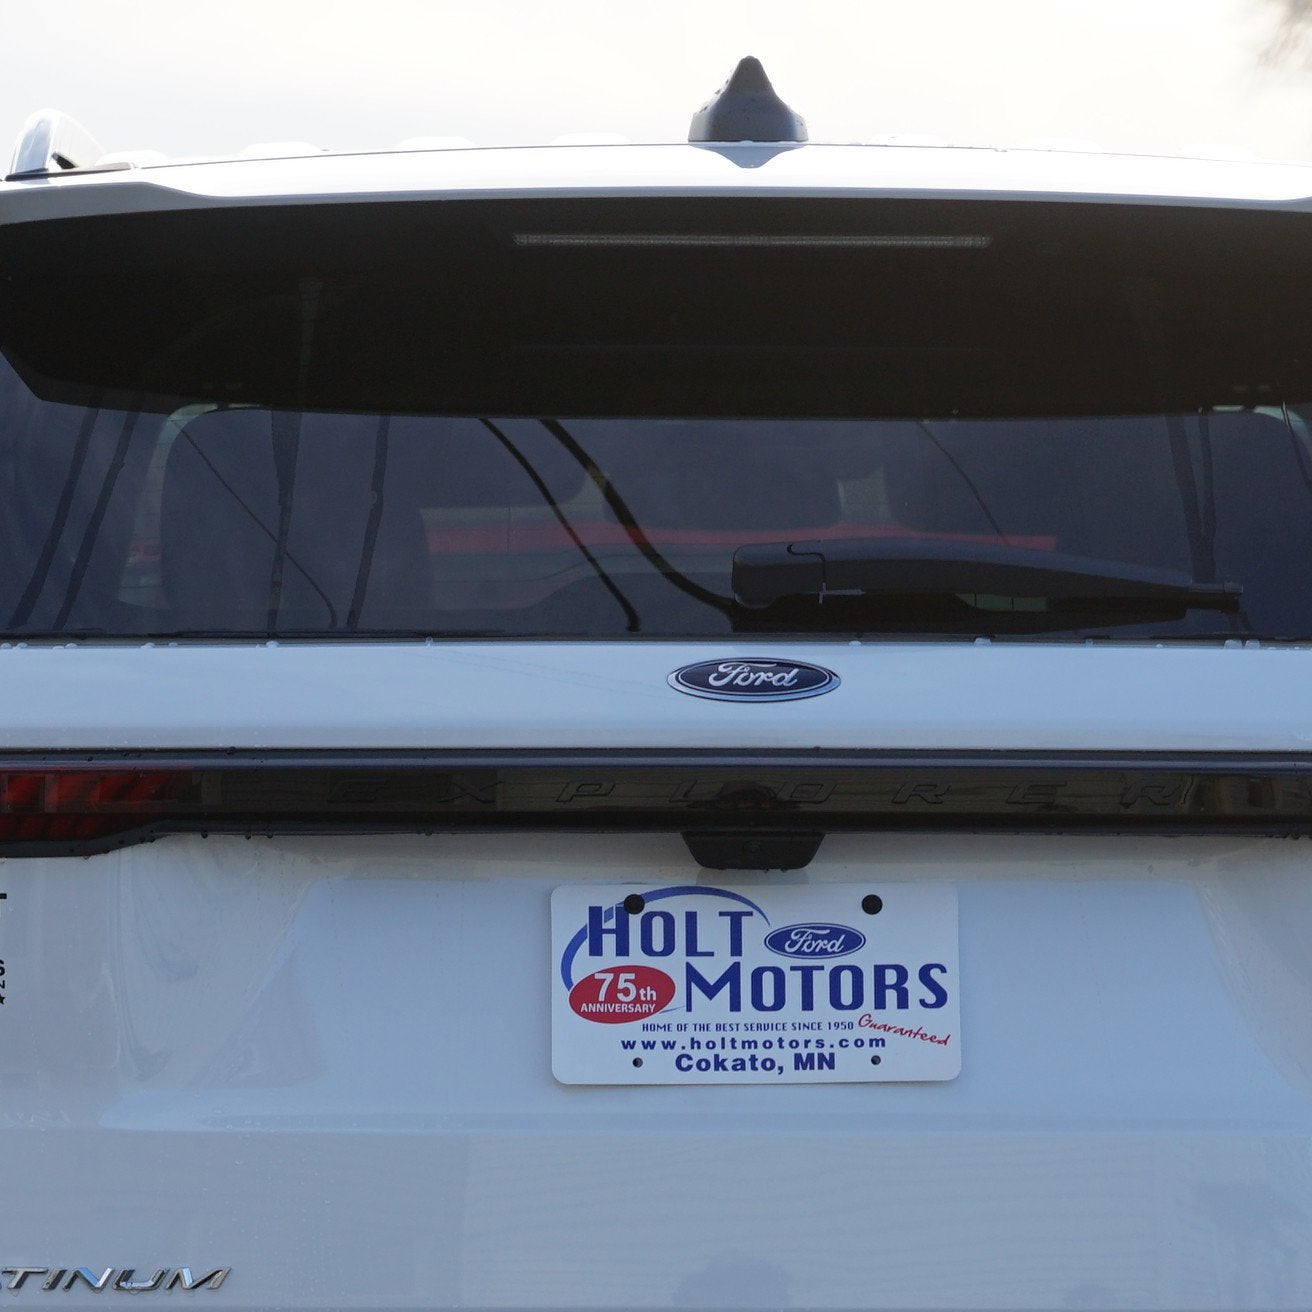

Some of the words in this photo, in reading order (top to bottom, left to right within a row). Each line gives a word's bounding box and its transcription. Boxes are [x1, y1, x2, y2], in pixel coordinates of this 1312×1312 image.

[708, 662, 800, 687] Ford
[588, 905, 754, 957] HOLT
[784, 928, 845, 954] Ford
[593, 972, 658, 1003] 75th
[685, 961, 949, 1013] MOTORS
[580, 1002, 657, 1014] ANNIVERSARY
[642, 1022, 673, 1032] HOME
[676, 1022, 689, 1032] OF
[692, 1022, 712, 1032] THE
[715, 1022, 739, 1032] BEST
[744, 1022, 788, 1032] SERVICE
[791, 1021, 823, 1031] SINCE
[828, 1021, 854, 1030] 1950
[857, 1013, 951, 1046] Guaranteed
[620, 1037, 887, 1050] www.holtmotors.com
[675, 1053, 785, 1075] Cokato,
[793, 1052, 836, 1071] MN
